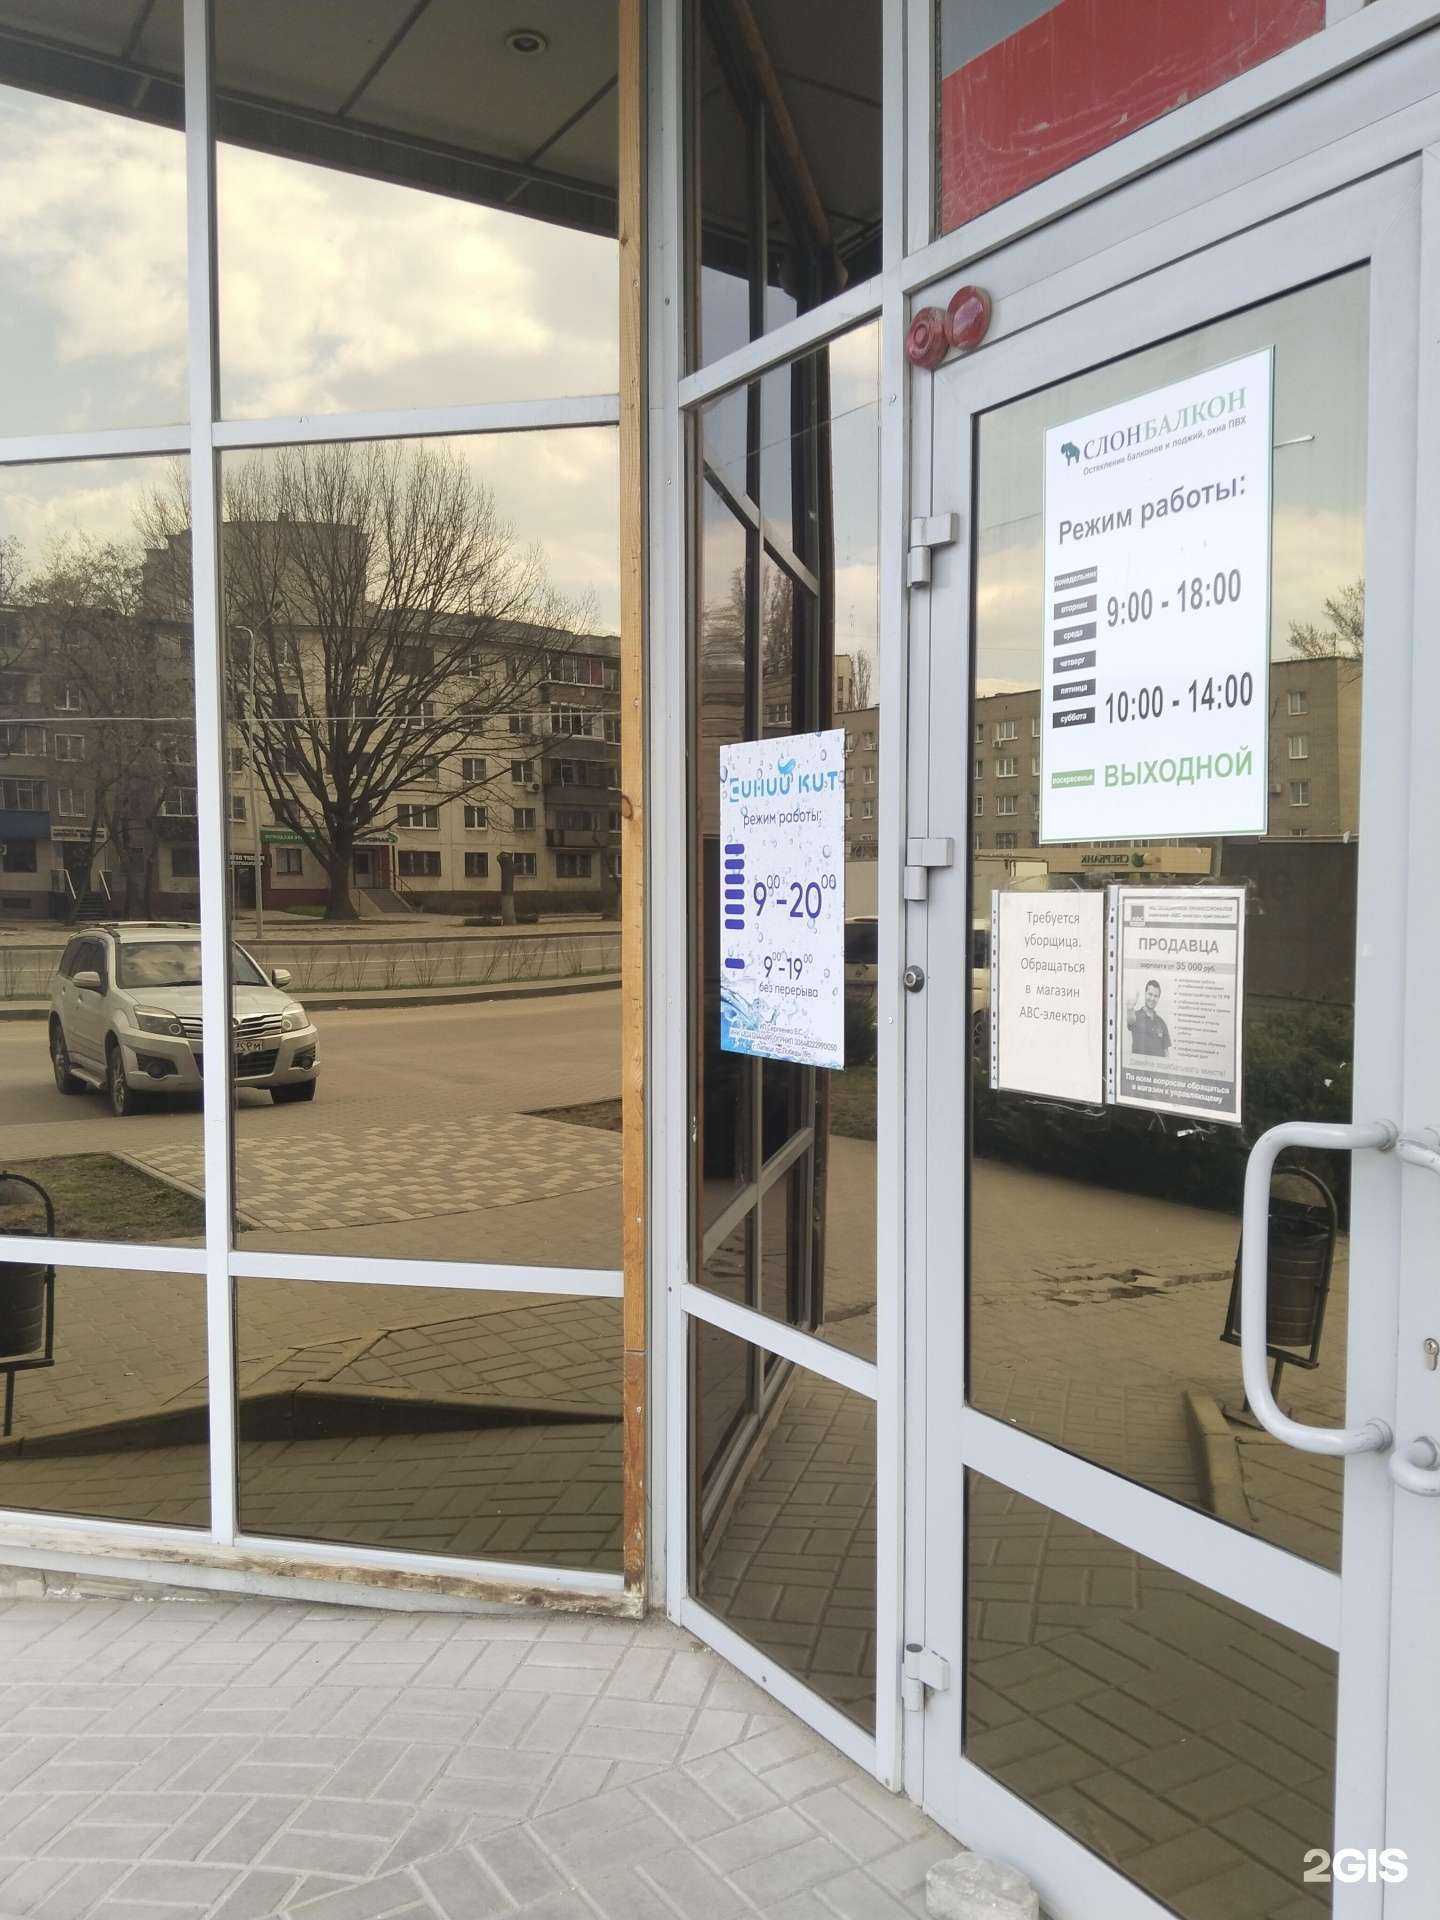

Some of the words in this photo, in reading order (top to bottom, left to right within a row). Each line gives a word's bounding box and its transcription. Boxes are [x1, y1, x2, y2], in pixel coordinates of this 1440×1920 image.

[1083, 387, 1248, 460] СЛОНБАЛКОН
[1127, 443, 1163, 462] балконов
[1228, 415, 1247, 429] ПВХ
[1058, 507, 1132, 544] Режим
[1140, 475, 1246, 528] работы:
[1107, 588, 1152, 627] 9:00
[1177, 568, 1241, 612] 18:00
[1063, 629, 1083, 641] среда
[1059, 657, 1086, 668] четверг
[1060, 684, 1088, 695] пятница
[1105, 685, 1163, 724] 10:00
[1188, 671, 1252, 713] 14:00
[1060, 711, 1087, 724] суббота
[1104, 745, 1253, 788] ВЫХОДНОЙ
[743, 814, 776, 828] режим
[779, 808, 822, 827] работы:
[1026, 911, 1080, 925] Требуется
[1024, 936, 1081, 949] уборщица.
[1138, 937, 1219, 956] ПРОДАВЦА
[1020, 957, 1085, 974] Обращаться
[1176, 961, 1186, 971] 35
[1187, 963, 1203, 973] 000
[759, 982, 773, 993] без
[774, 984, 819, 998] перерыва
[1025, 985, 1031, 994] в
[1036, 984, 1080, 998] магазин
[1019, 1008, 1086, 1025] АВС-электро
[1153, 1078, 1186, 1089] вопросам
[1187, 1081, 1230, 1094] обращаться
